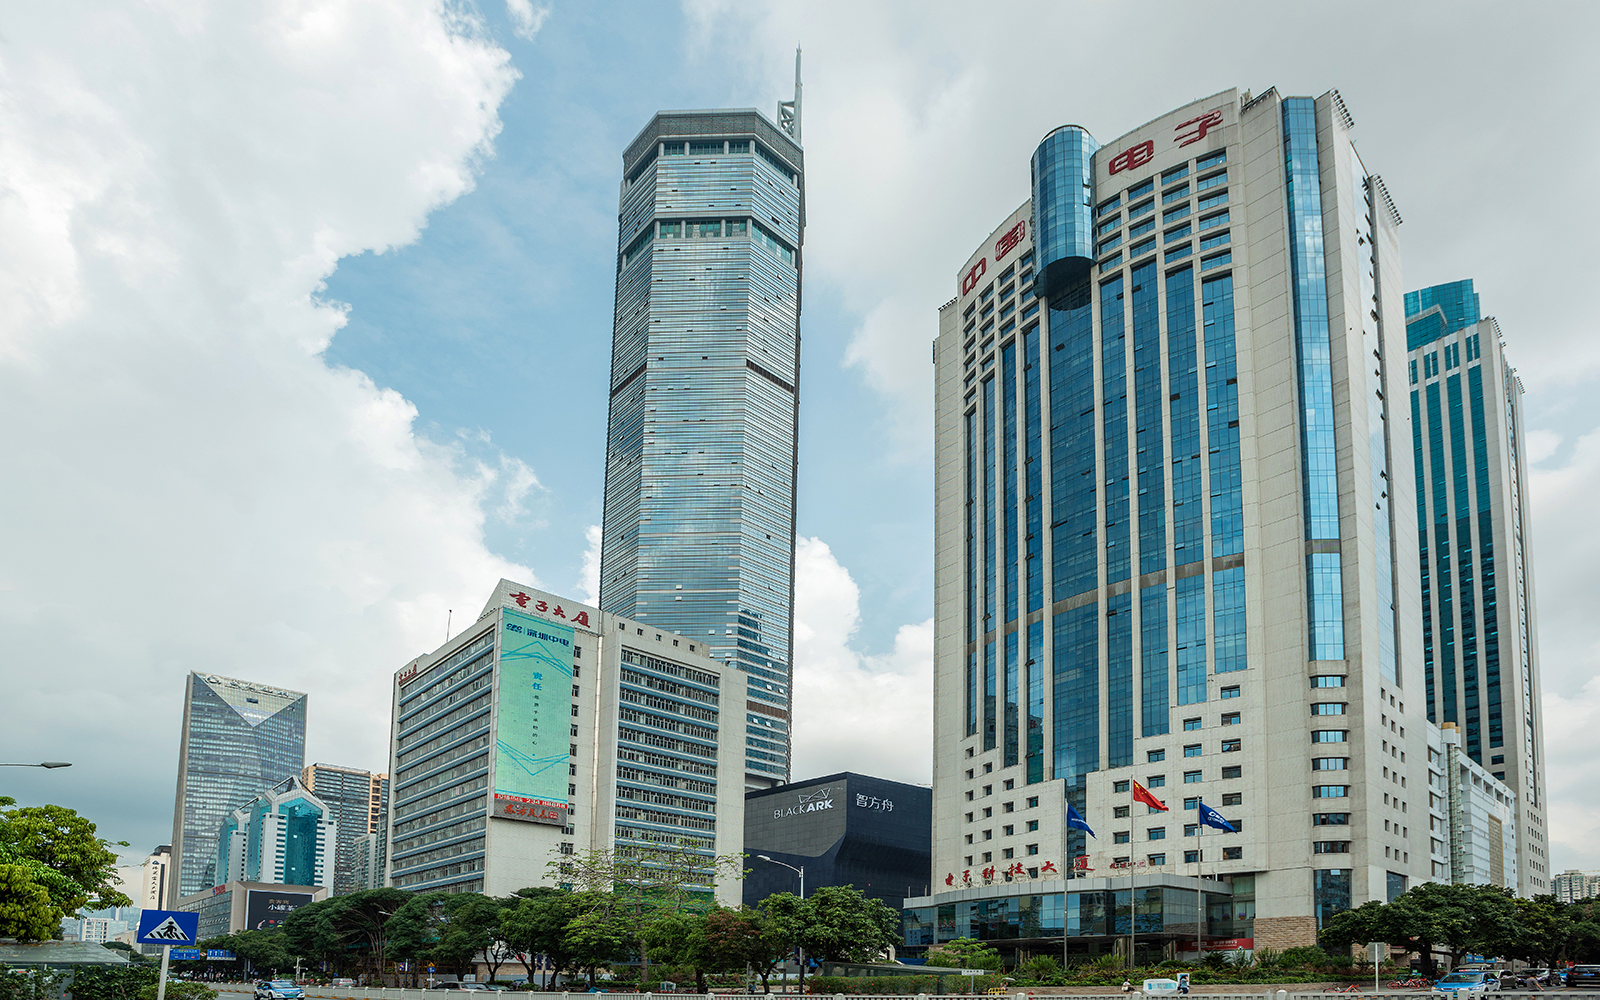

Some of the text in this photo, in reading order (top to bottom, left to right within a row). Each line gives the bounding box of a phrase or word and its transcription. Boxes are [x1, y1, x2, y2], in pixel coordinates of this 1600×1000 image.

[855, 792, 895, 813] 智方舟
[945, 854, 1096, 886] 电子科技大厦
